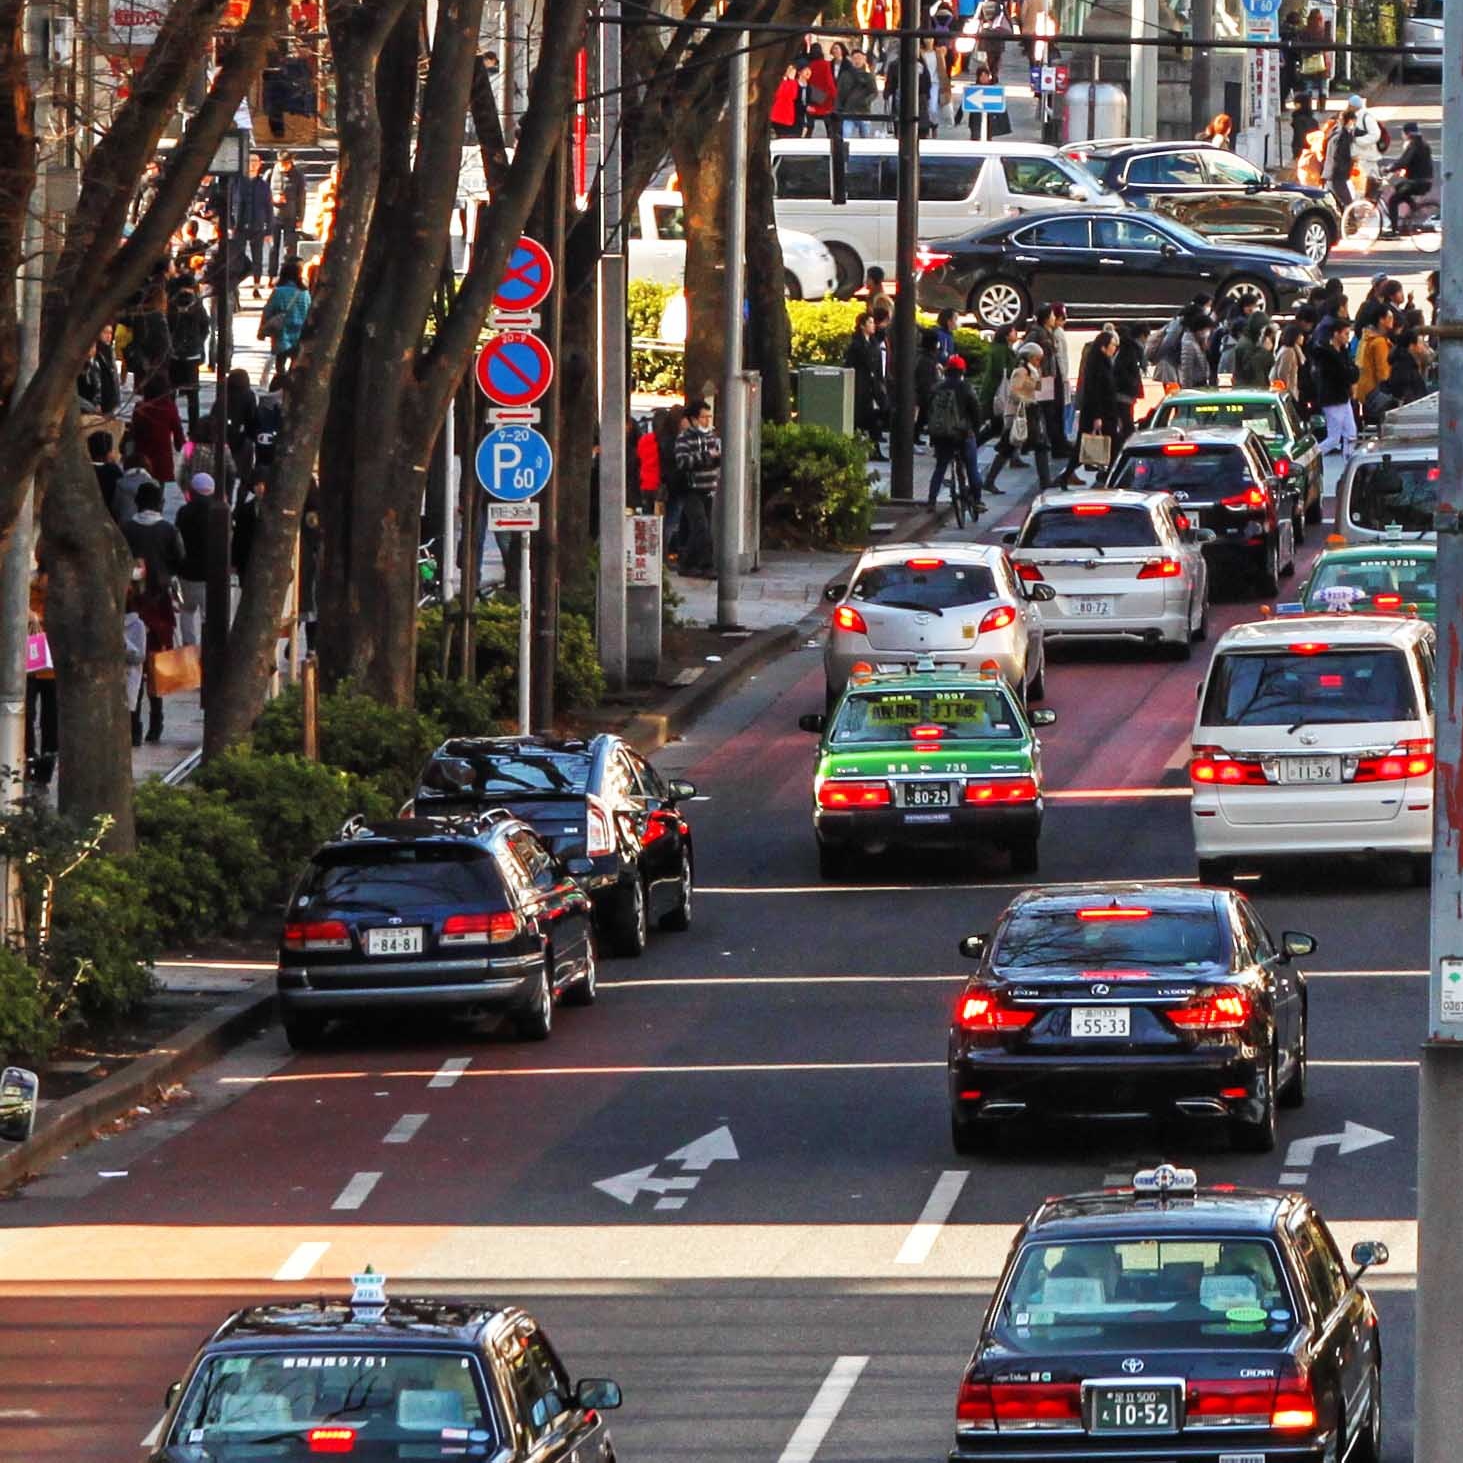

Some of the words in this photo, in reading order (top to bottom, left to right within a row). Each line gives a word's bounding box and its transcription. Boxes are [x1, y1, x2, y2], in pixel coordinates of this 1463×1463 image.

[498, 430, 529, 442] 9-20
[493, 443, 522, 489] P
[513, 468, 534, 489] 60
[1299, 766, 1331, 779] 11-36
[381, 938, 417, 952] 84-81
[1084, 1019, 1127, 1034] 55-33
[1240, 1369, 1274, 1378] CROWN
[1115, 1403, 1169, 1425] 10-52
